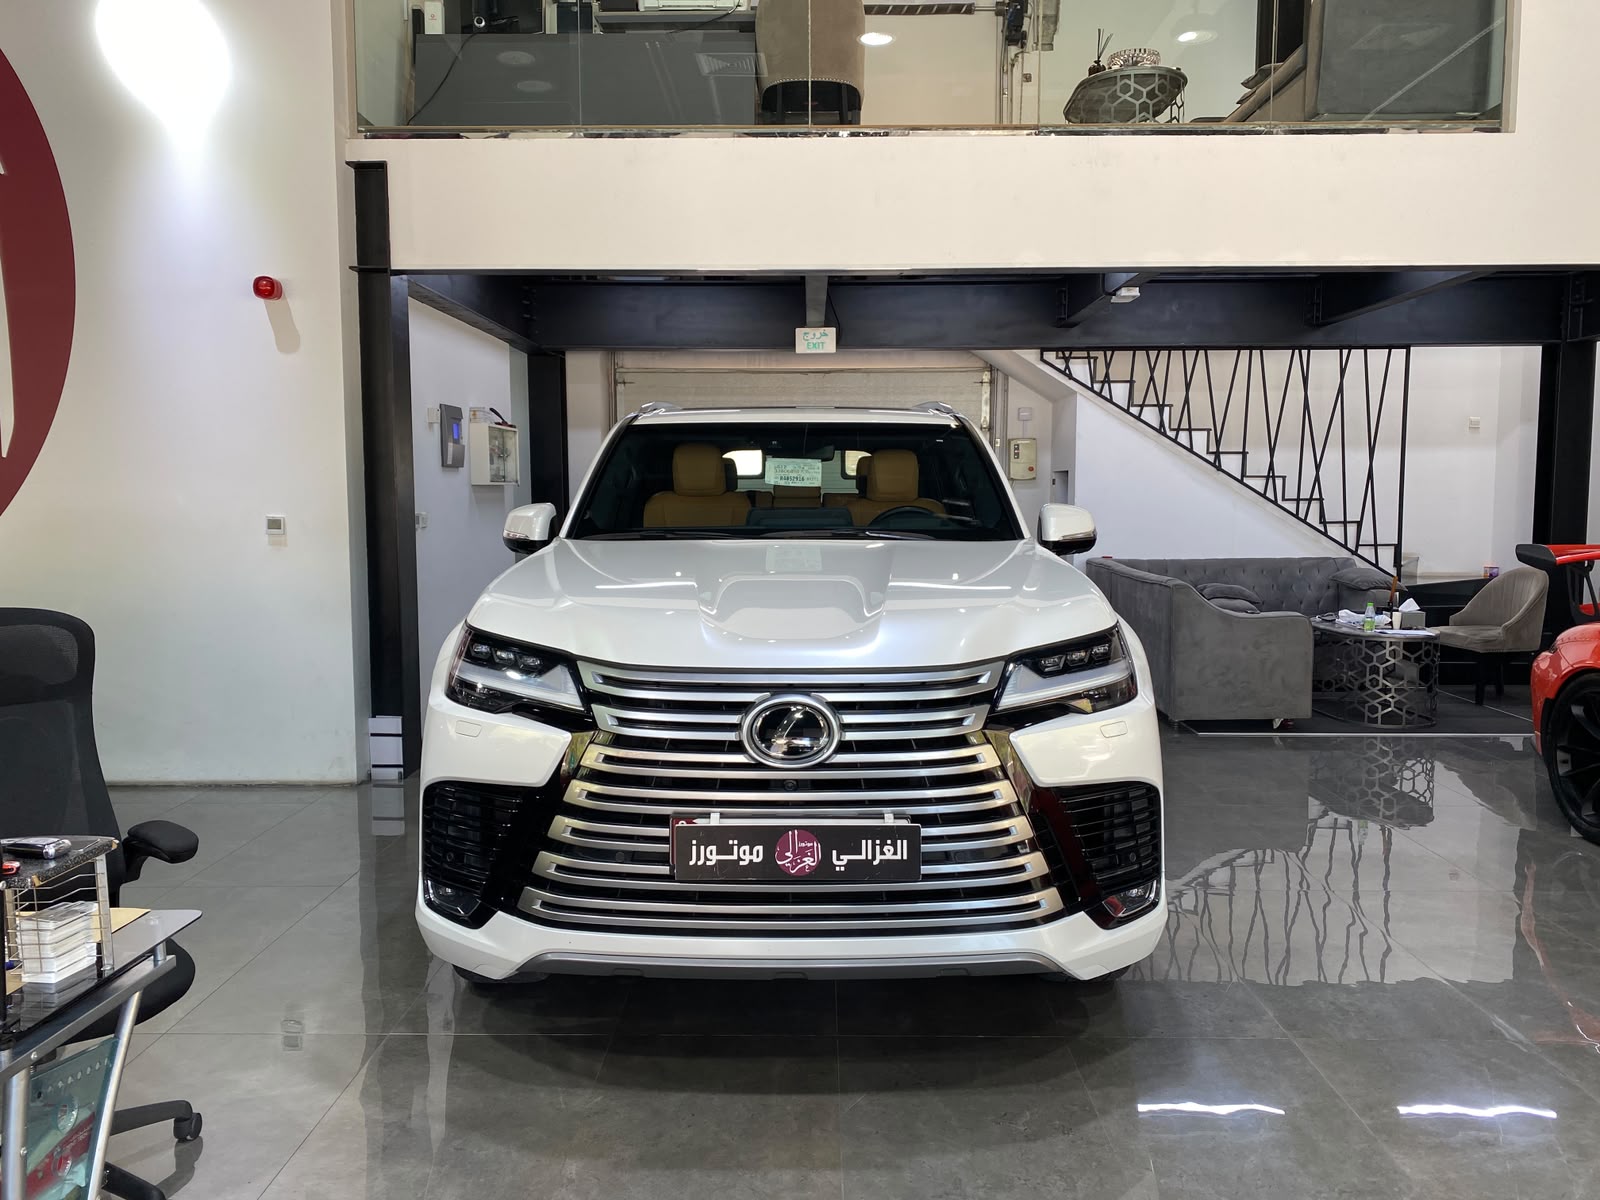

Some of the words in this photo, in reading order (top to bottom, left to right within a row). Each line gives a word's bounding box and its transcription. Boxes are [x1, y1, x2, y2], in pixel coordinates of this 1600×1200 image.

[803, 329, 829, 341] خروج
[806, 342, 825, 350] EXIT
[688, 839, 764, 866] موتورز
[831, 839, 908, 872] الغزالي
